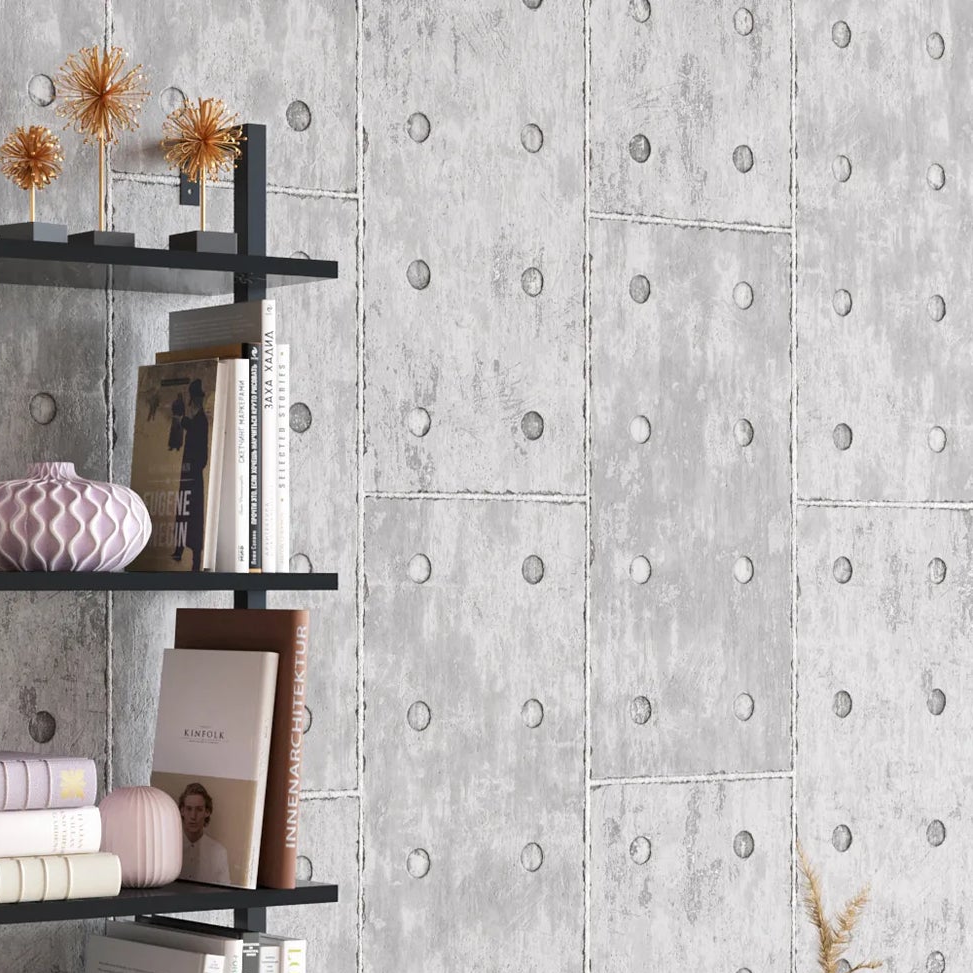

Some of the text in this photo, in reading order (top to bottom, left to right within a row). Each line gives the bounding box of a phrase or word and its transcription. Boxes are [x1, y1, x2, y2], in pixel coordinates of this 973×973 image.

[238, 379, 246, 464] СКЕТЧИНГ МАРКЕРАМИ
[264, 379, 274, 410] ЗАХА
[278, 363, 286, 489] SELECTED STORIES
[151, 521, 188, 548] NEGIN
[184, 728, 225, 740] KINFOLK
[285, 625, 307, 849] INNENARCHITEKTUR
